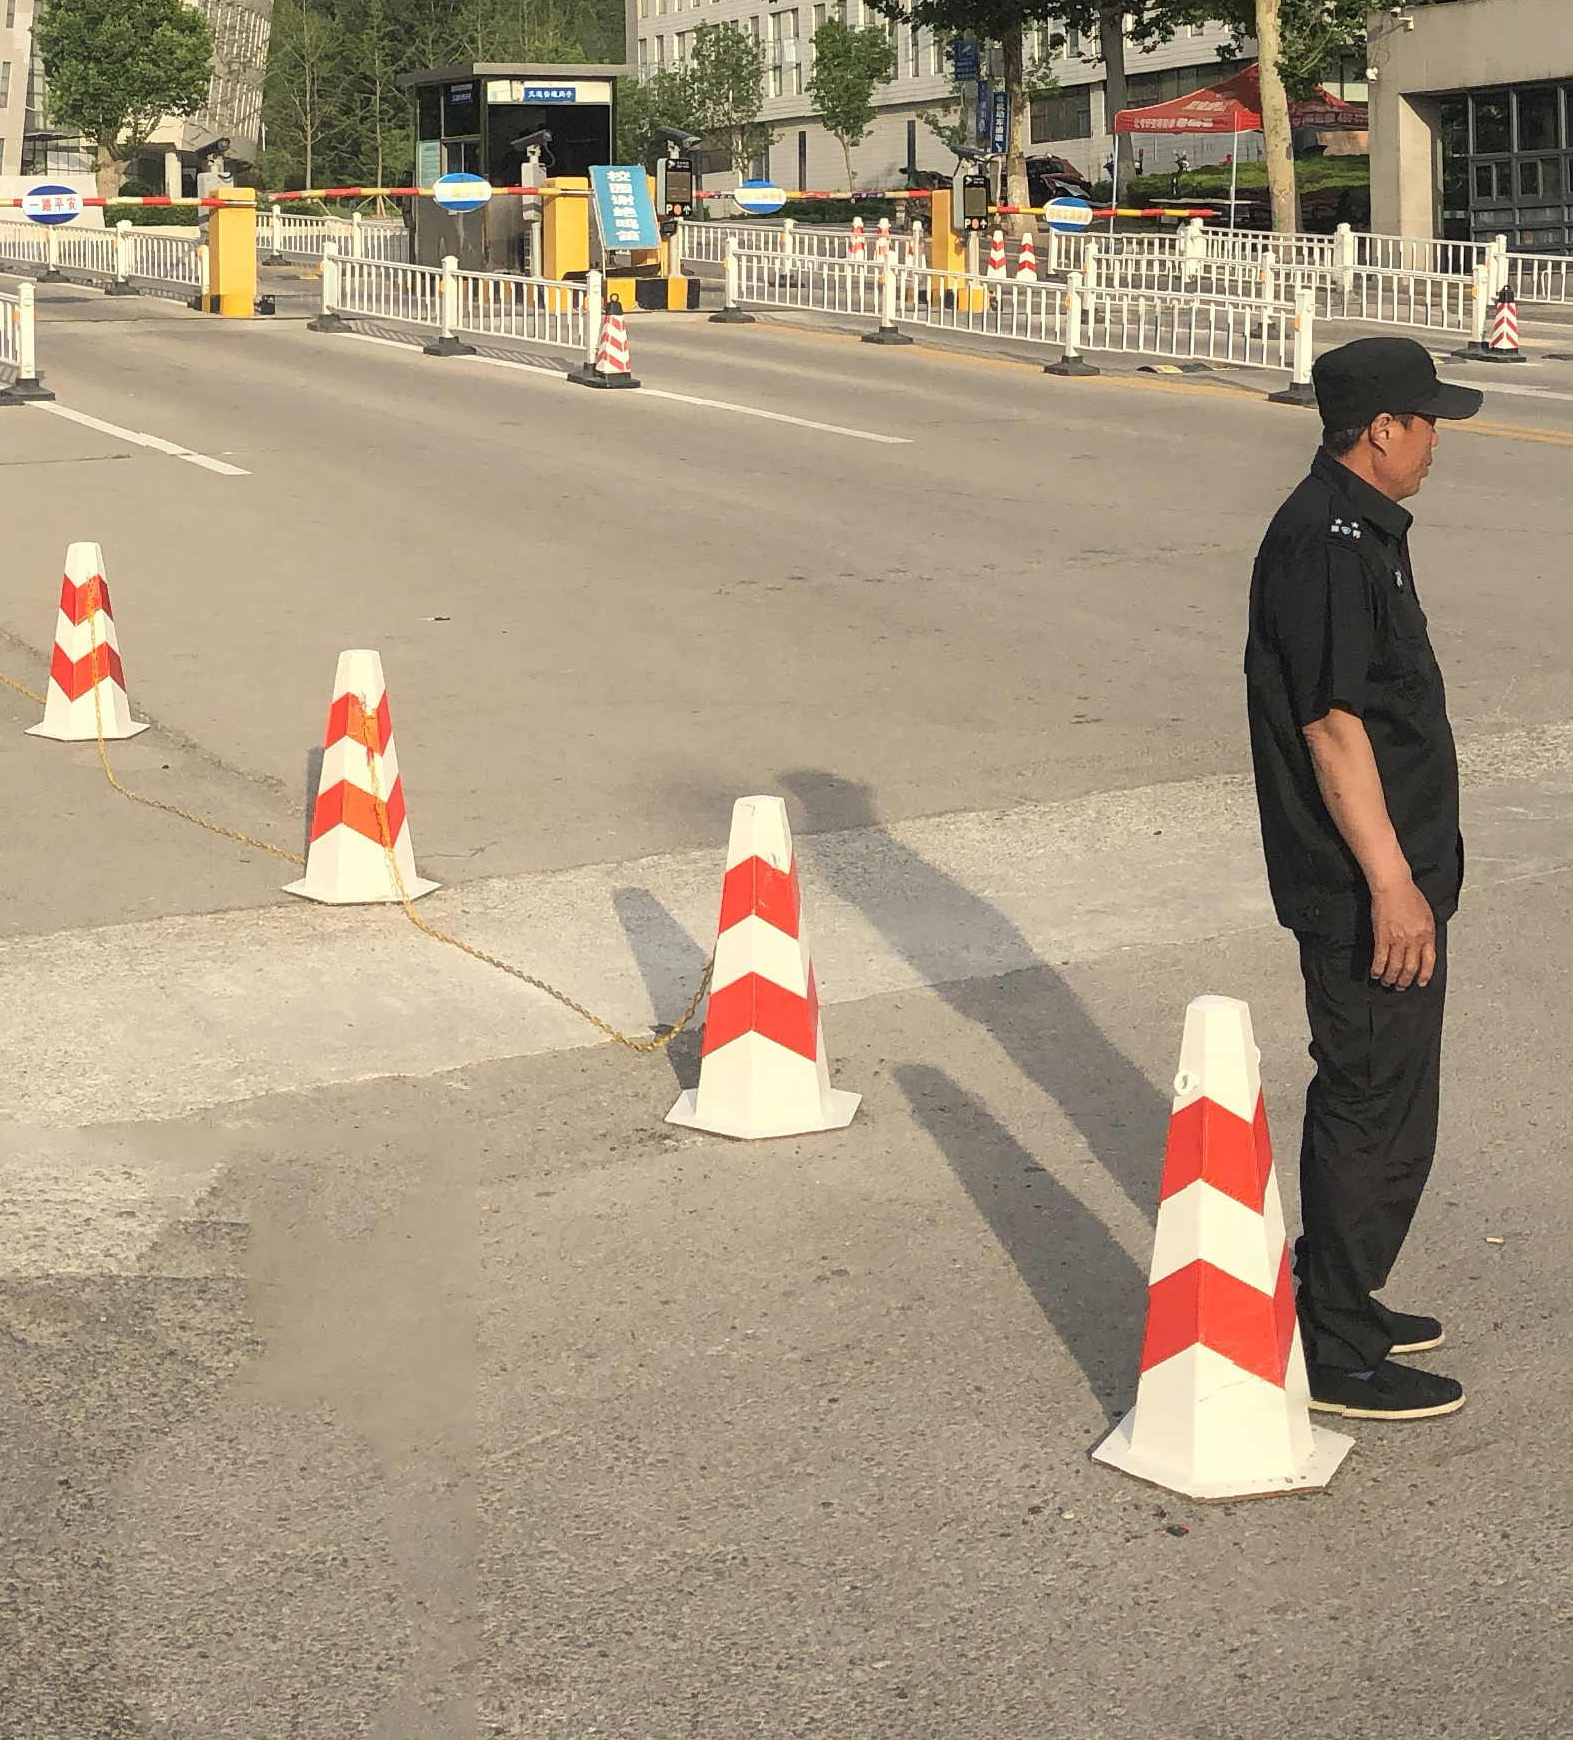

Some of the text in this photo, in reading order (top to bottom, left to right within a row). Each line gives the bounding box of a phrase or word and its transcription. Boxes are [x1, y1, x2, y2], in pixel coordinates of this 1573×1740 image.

[29, 197, 77, 211] 一路平安
[964, 218, 971, 229] P
